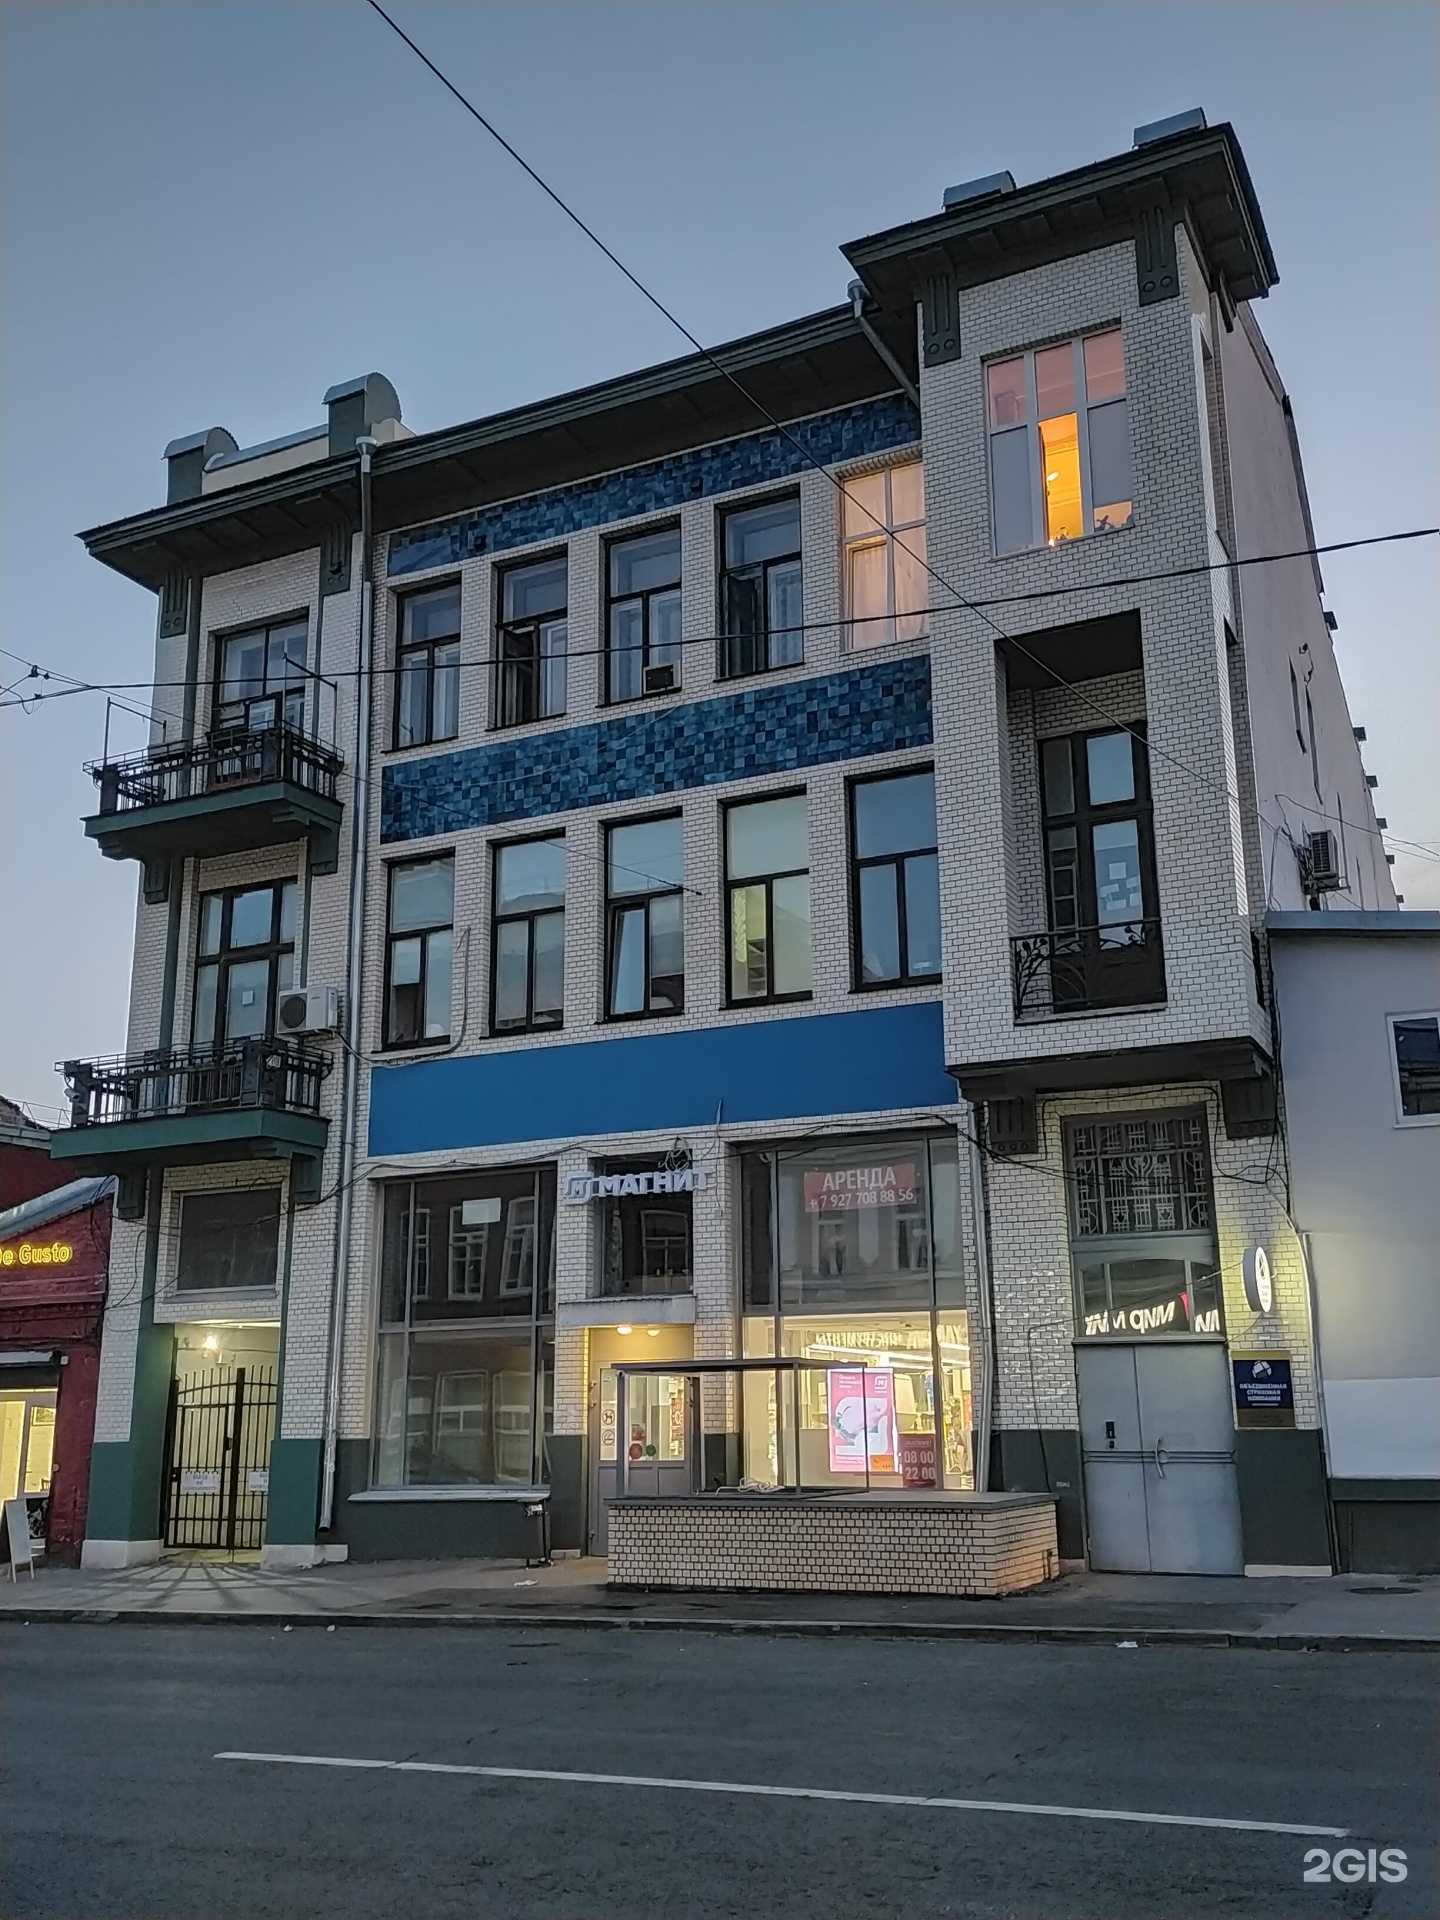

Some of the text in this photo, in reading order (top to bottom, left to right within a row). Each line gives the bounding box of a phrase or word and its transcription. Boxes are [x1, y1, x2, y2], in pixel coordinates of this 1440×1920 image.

[600, 1166, 714, 1197] МАГНИТ
[822, 1167, 897, 1191] АРЕНДА
[830, 1193, 852, 1207] 927
[856, 1191, 877, 1204] 708
[880, 1189, 895, 1202] 88
[898, 1187, 914, 1201] 56
[0, 1242, 73, 1266] e Gusto
